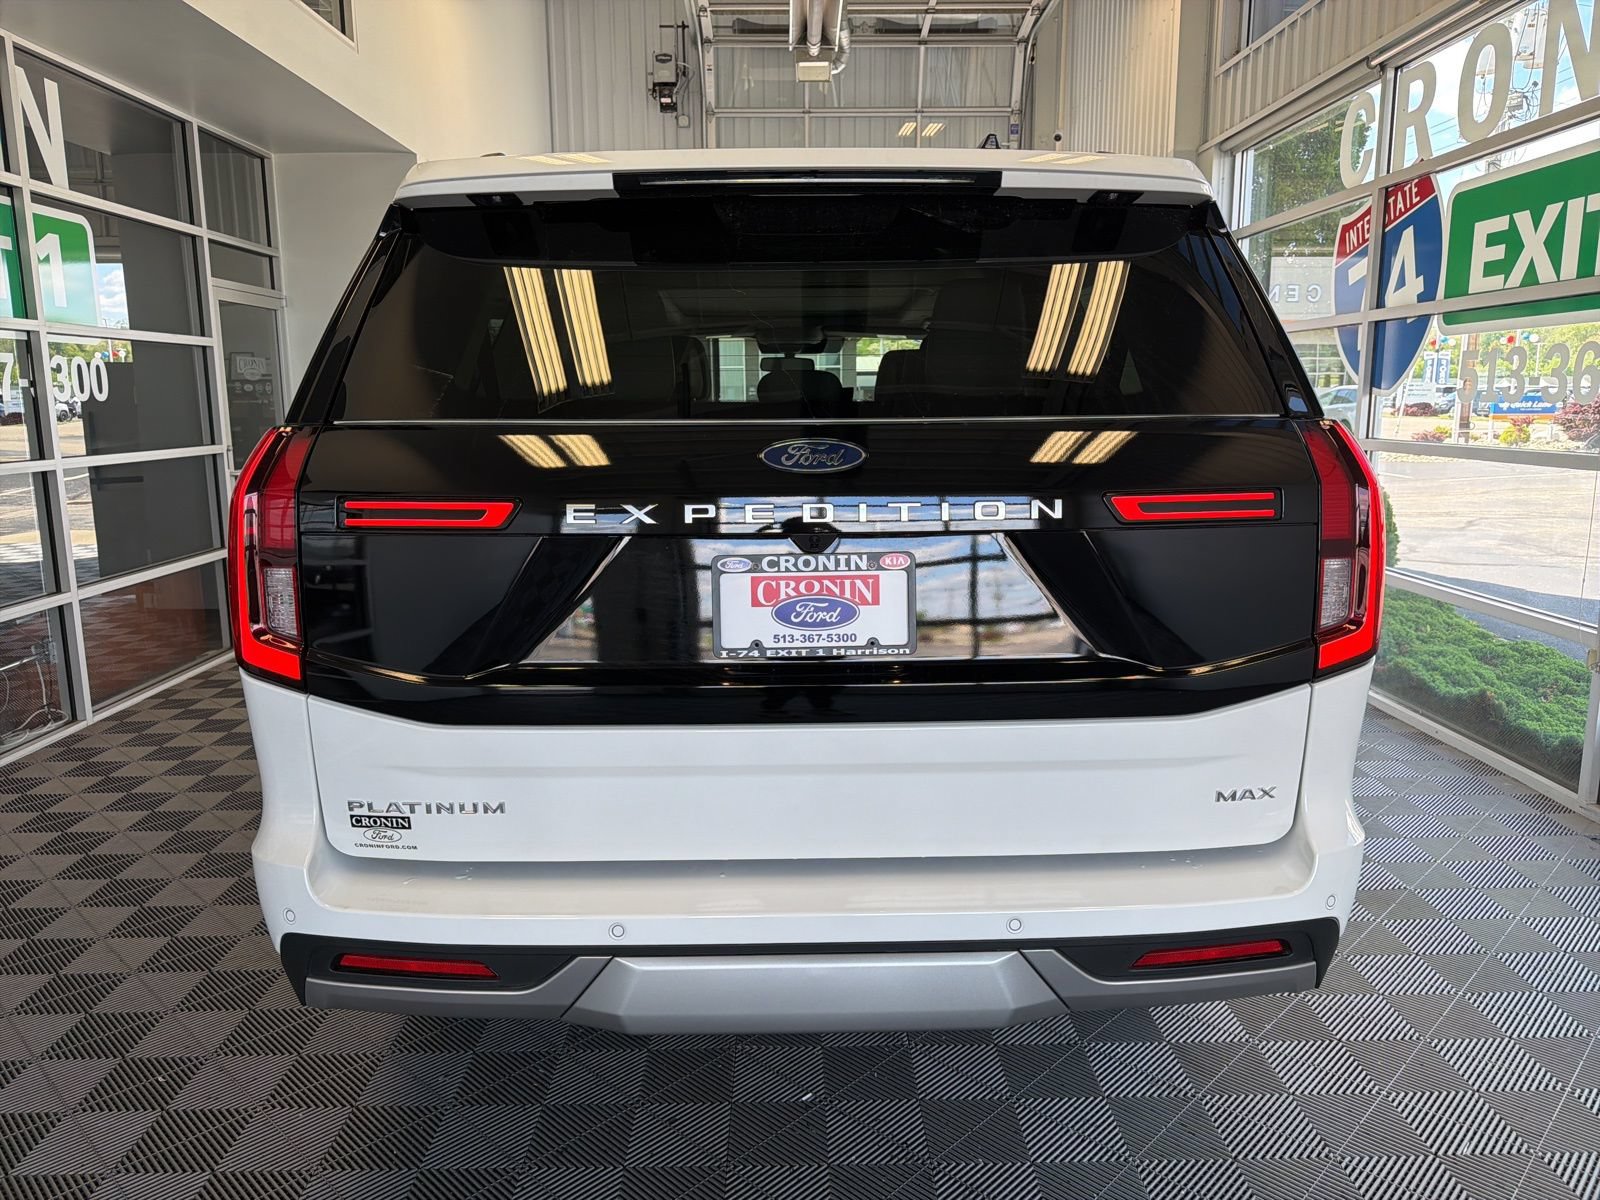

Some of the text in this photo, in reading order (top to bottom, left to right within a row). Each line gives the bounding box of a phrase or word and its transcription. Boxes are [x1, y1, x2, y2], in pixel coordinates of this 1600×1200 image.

[1345, 178, 1421, 254] INTETATE
[781, 444, 845, 465] Ford
[565, 499, 1063, 524] EXPEDITION
[724, 560, 745, 569] Ford
[761, 554, 868, 572] CRONIN
[885, 556, 906, 566] KIA
[757, 578, 875, 606] CRONIN
[790, 601, 841, 623] Ford
[772, 633, 858, 644] 513-367-5300
[720, 646, 910, 658] I-74 EXIT 1 Harrison
[1215, 785, 1277, 803] MAX
[347, 800, 506, 815] PLATINUM
[351, 816, 410, 828] CRONIN
[371, 829, 395, 841] Ford
[354, 842, 418, 850] CRONINFORD.COM
